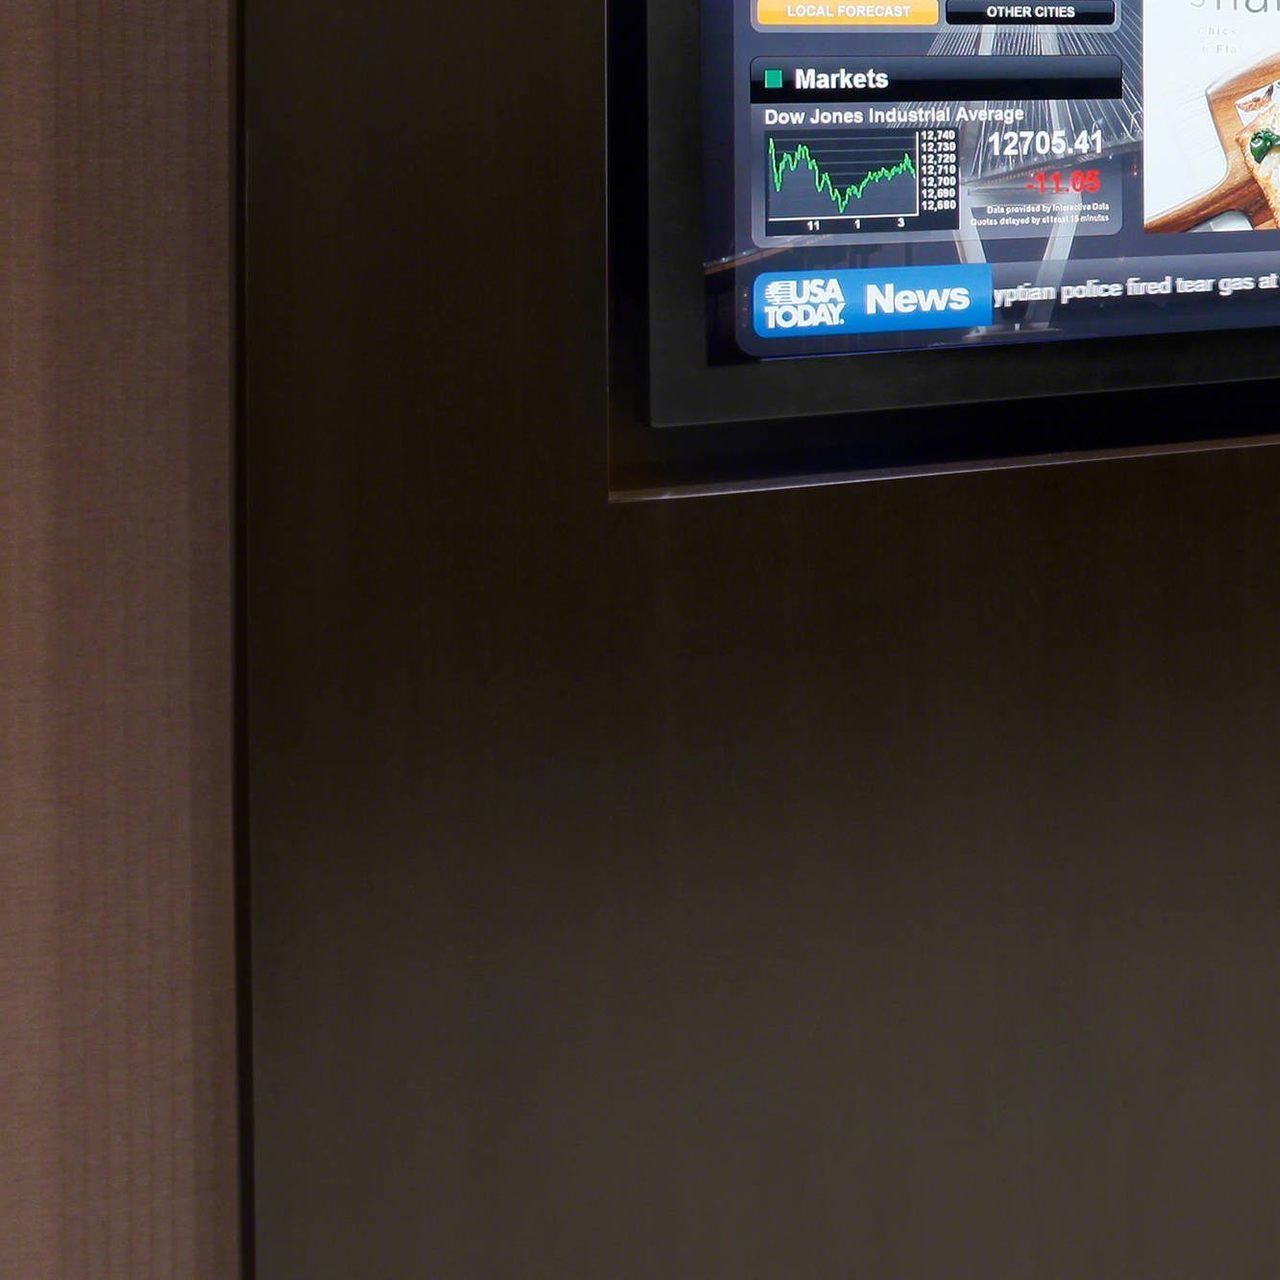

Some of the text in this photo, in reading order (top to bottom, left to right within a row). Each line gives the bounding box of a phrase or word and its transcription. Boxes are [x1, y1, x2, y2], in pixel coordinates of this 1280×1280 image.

[786, 5, 911, 17] LOCAL FORECAST
[987, 6, 1075, 18] OTHER CITIES
[796, 68, 889, 89] Markets
[765, 107, 1024, 124] Dow Jones Industrial Average
[920, 130, 956, 141] 12,740
[988, 130, 1103, 156] 12705.41
[921, 165, 956, 176] 12,710
[921, 176, 956, 188] 12,700
[807, 218, 905, 231] 11 1 3
[790, 278, 846, 303] USA
[1061, 278, 1123, 304] police
[1126, 276, 1172, 297] fired
[1175, 276, 1216, 294] tear
[1218, 275, 1255, 296] gas
[1258, 272, 1280, 291] at
[866, 283, 971, 315] News
